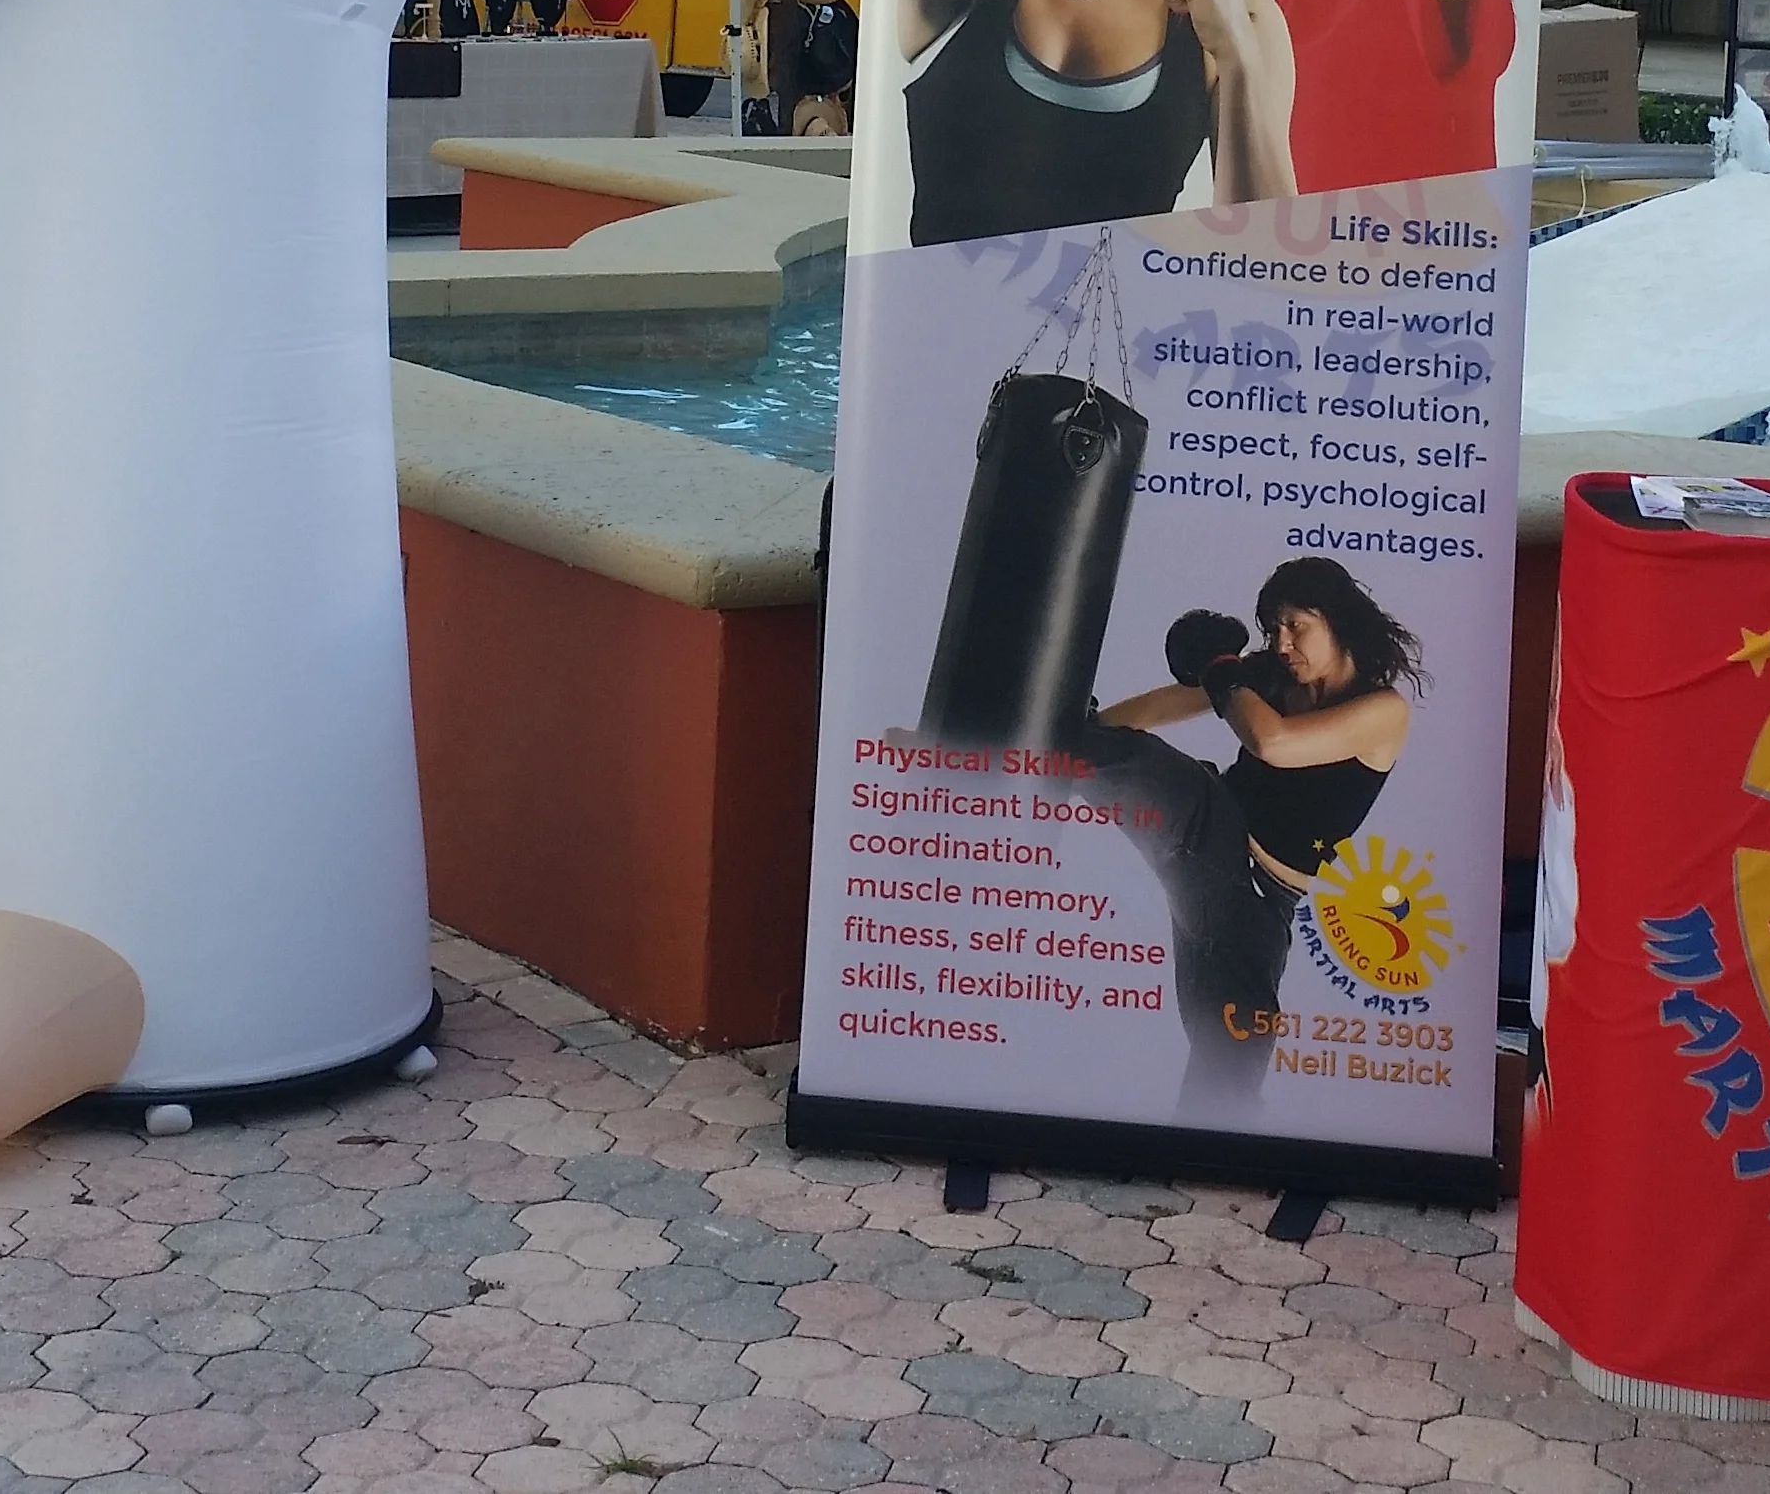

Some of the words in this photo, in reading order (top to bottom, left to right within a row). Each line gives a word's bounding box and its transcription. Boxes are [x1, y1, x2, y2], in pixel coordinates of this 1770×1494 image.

[1330, 216, 1391, 243] Life
[1402, 220, 1498, 250] Skills:
[1142, 249, 1327, 284] Confidence
[1338, 260, 1370, 286] to
[1381, 263, 1496, 293] defend
[1287, 300, 1314, 327] in
[1326, 306, 1494, 337] real-world
[1154, 338, 1302, 373] situation,
[1314, 346, 1492, 385] leadership,
[1186, 386, 1308, 414] conflict
[1318, 394, 1490, 428] resolution,
[1169, 430, 1298, 460] respect,
[1310, 434, 1406, 467] focus,
[1416, 442, 1488, 469] self-
[1134, 471, 1252, 502] control,
[1263, 480, 1486, 517] psychological
[1286, 523, 1483, 562] advantages.
[855, 739, 991, 773] Physical
[1002, 748, 1097, 779] Skills:
[852, 783, 1022, 819] Significant
[1032, 794, 1124, 826] boost
[1134, 802, 1163, 831] in
[849, 832, 1062, 870] coordination,
[847, 876, 962, 904] muscle
[972, 885, 1116, 921] memory,
[844, 915, 958, 951] fitness,
[969, 927, 1027, 954] self
[1035, 932, 1166, 965] defense
[1294, 903, 1359, 999] MARTIAL
[1363, 995, 1431, 1016] ARTS
[1322, 905, 1371, 971] RISING
[1375, 966, 1419, 987] SUN
[841, 962, 926, 995] skills,
[937, 967, 1091, 1010] flexibility,
[1102, 985, 1163, 1011] and
[839, 1008, 1007, 1044] quickness.
[1253, 1010, 1301, 1039] 561
[1312, 1014, 1367, 1044] 222
[1376, 1020, 1454, 1052] 3903
[1274, 1047, 1336, 1077] Neil
[1347, 1053, 1453, 1088] Buzick
